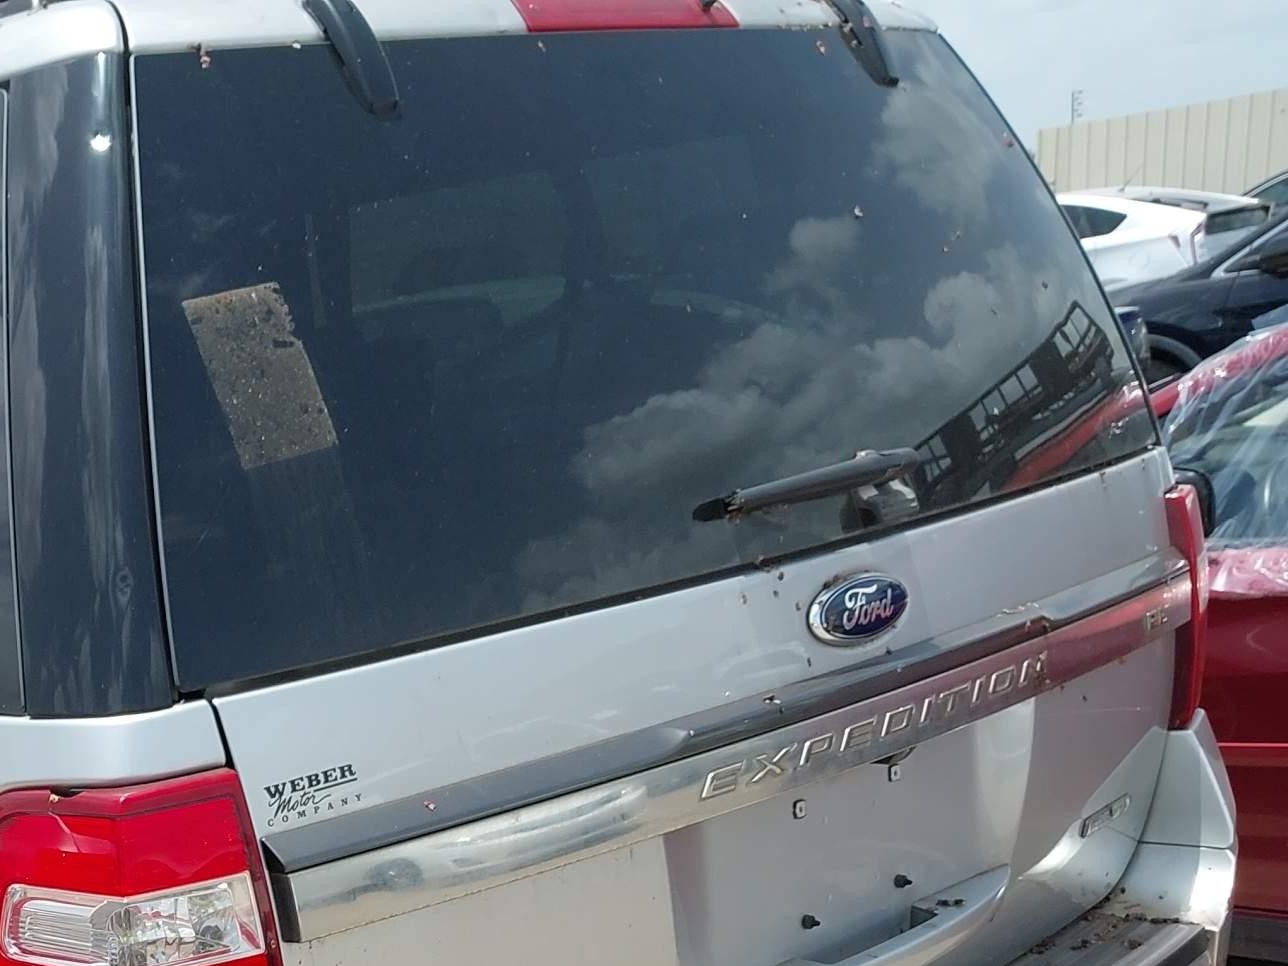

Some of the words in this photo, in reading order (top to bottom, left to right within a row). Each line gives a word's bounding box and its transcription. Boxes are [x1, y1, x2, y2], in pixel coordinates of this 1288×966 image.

[842, 583, 895, 630] Ford
[699, 651, 1050, 801] EXPEDITION
[264, 764, 357, 799] WEBER
[267, 793, 362, 828] COMPANY
[269, 791, 331, 819] Motor
